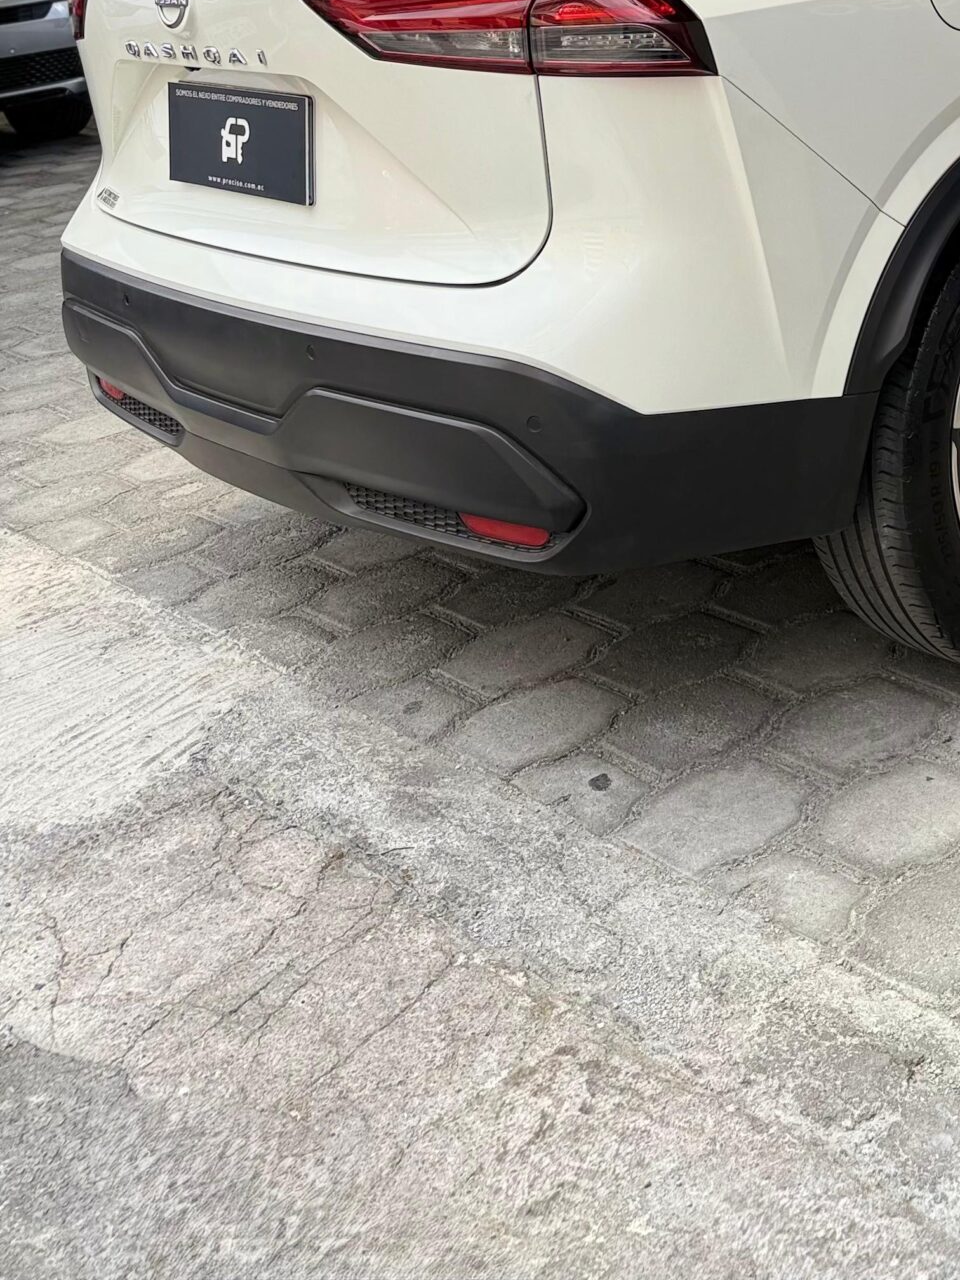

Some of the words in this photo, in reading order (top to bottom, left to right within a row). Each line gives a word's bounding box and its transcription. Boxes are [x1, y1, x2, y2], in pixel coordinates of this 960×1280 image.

[125, 40, 268, 66] QASHQAI
[176, 89, 192, 97] SOMOS
[212, 93, 226, 101] ENTRE
[226, 95, 261, 106] COMPRADORES
[266, 100, 298, 110] VENDEDORES
